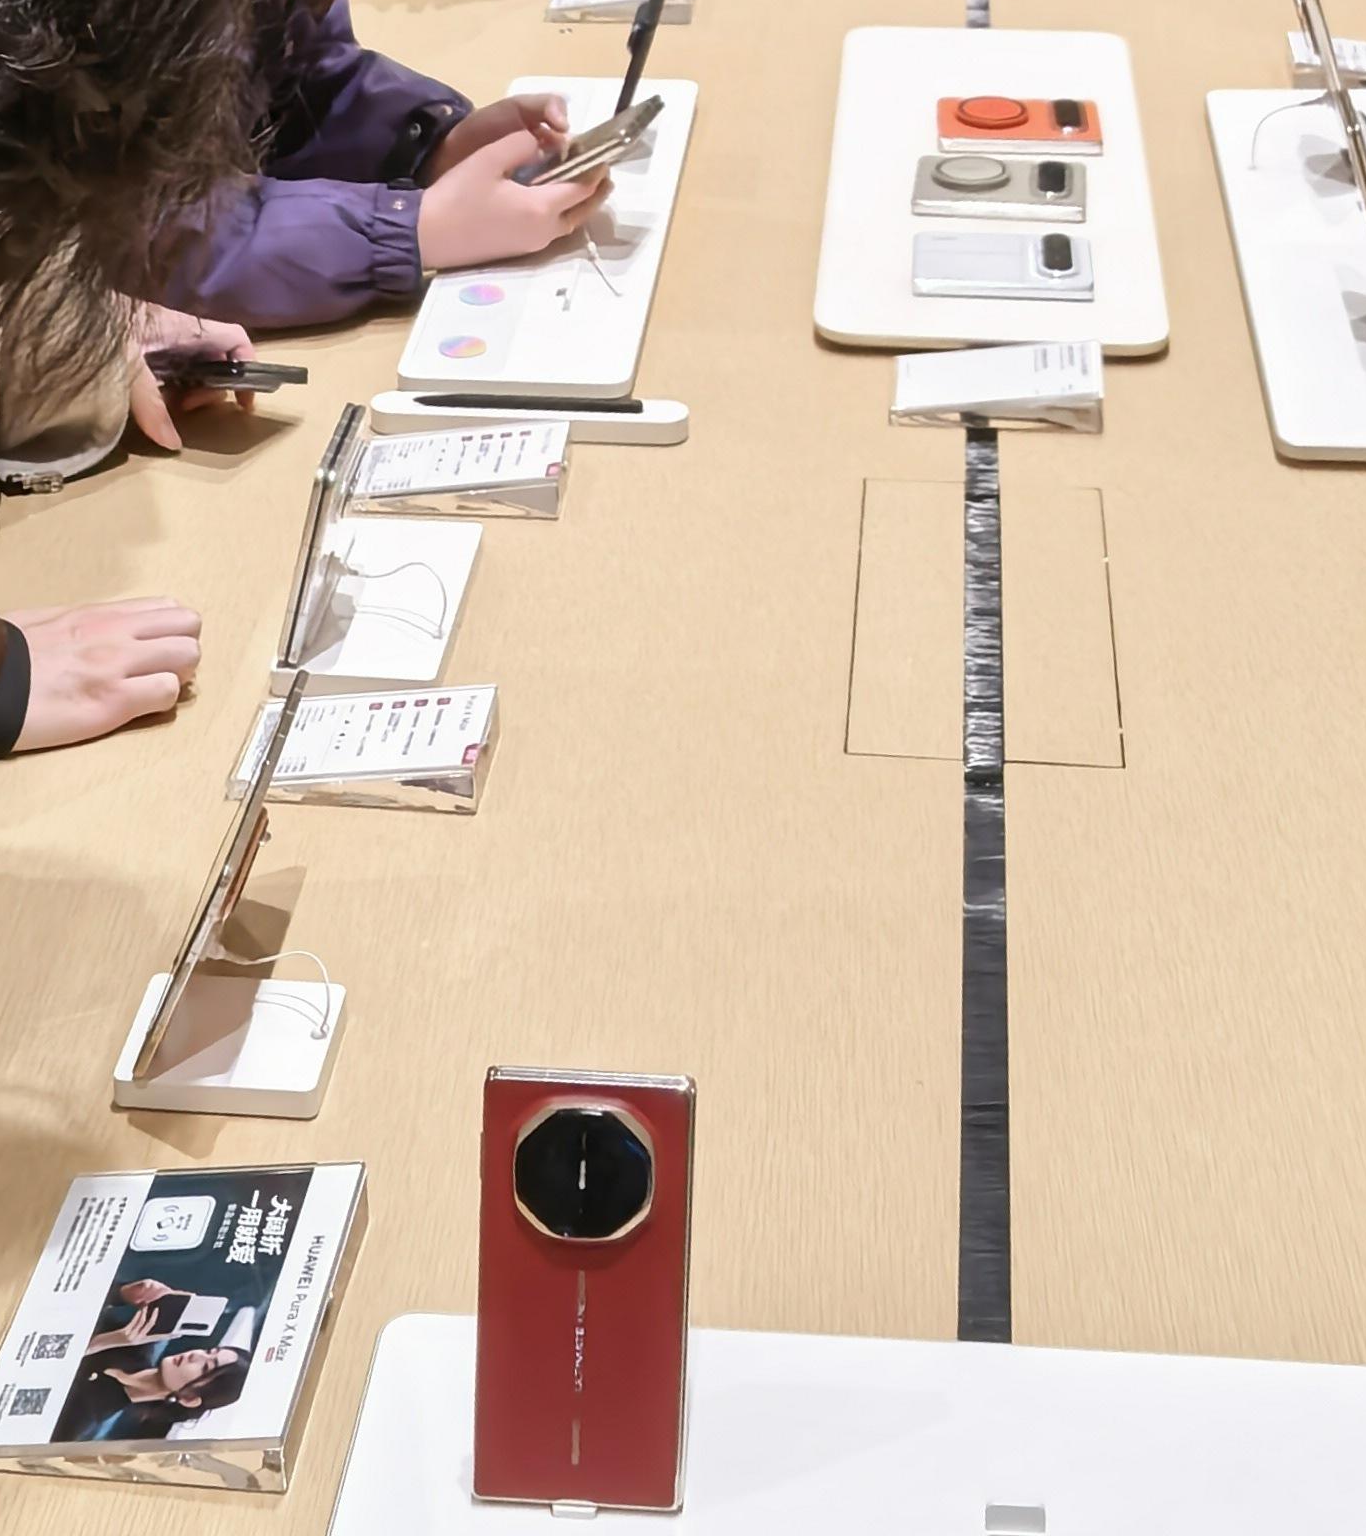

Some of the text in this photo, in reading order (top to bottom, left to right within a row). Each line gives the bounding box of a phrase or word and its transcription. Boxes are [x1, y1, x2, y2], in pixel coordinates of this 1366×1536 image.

[225, 1189, 263, 1264] 一用就爱
[257, 1194, 292, 1256] 大阔折
[275, 1235, 325, 1362] HUAWEI Pura X Max
